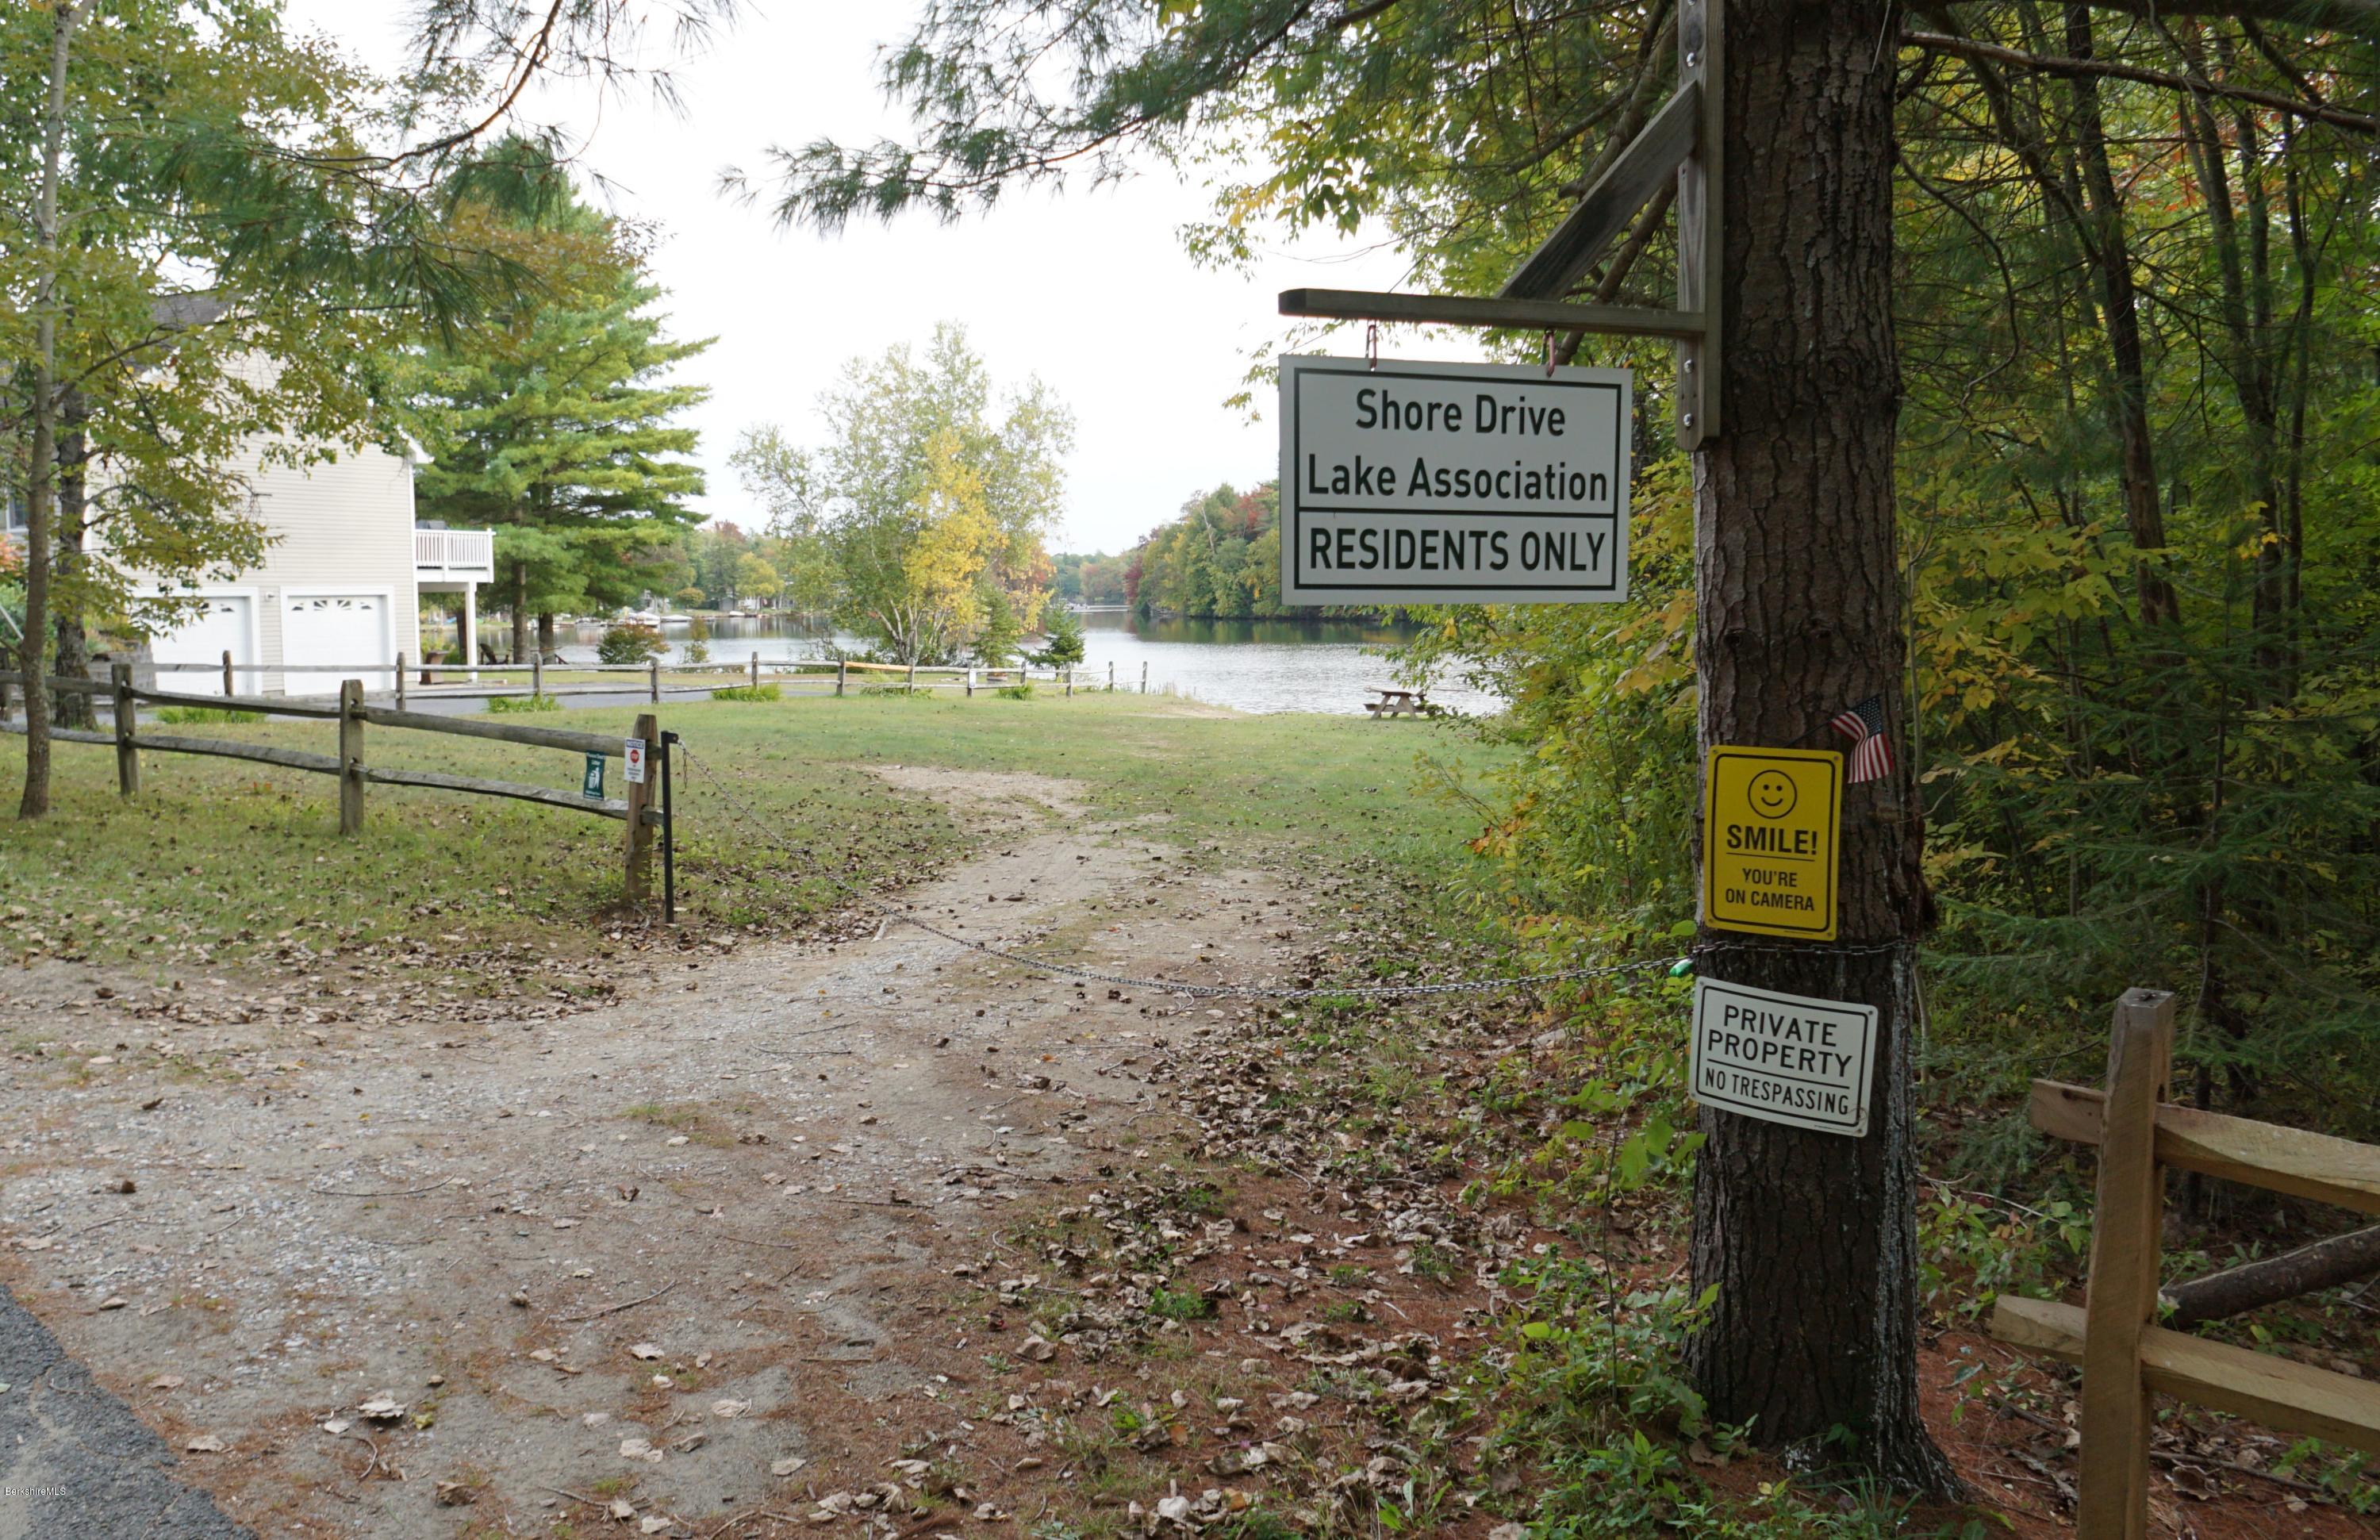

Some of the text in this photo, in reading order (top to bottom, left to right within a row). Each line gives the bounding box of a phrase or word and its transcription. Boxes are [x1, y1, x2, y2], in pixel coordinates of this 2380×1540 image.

[1355, 388, 1566, 437] Shore Drive
[1308, 453, 1607, 501] Lake Association
[1311, 527, 1606, 572] RESIDENTS ONLY
[1726, 824, 1818, 855] SMILE!
[1726, 888, 1815, 912] ON CAMERA
[1742, 868, 1798, 888] YOU'RE
[1723, 1004, 1837, 1047] PRIVATE
[1707, 1029, 1853, 1077] PROPERTY
[1705, 1067, 1849, 1116] NO TRESPASSING
